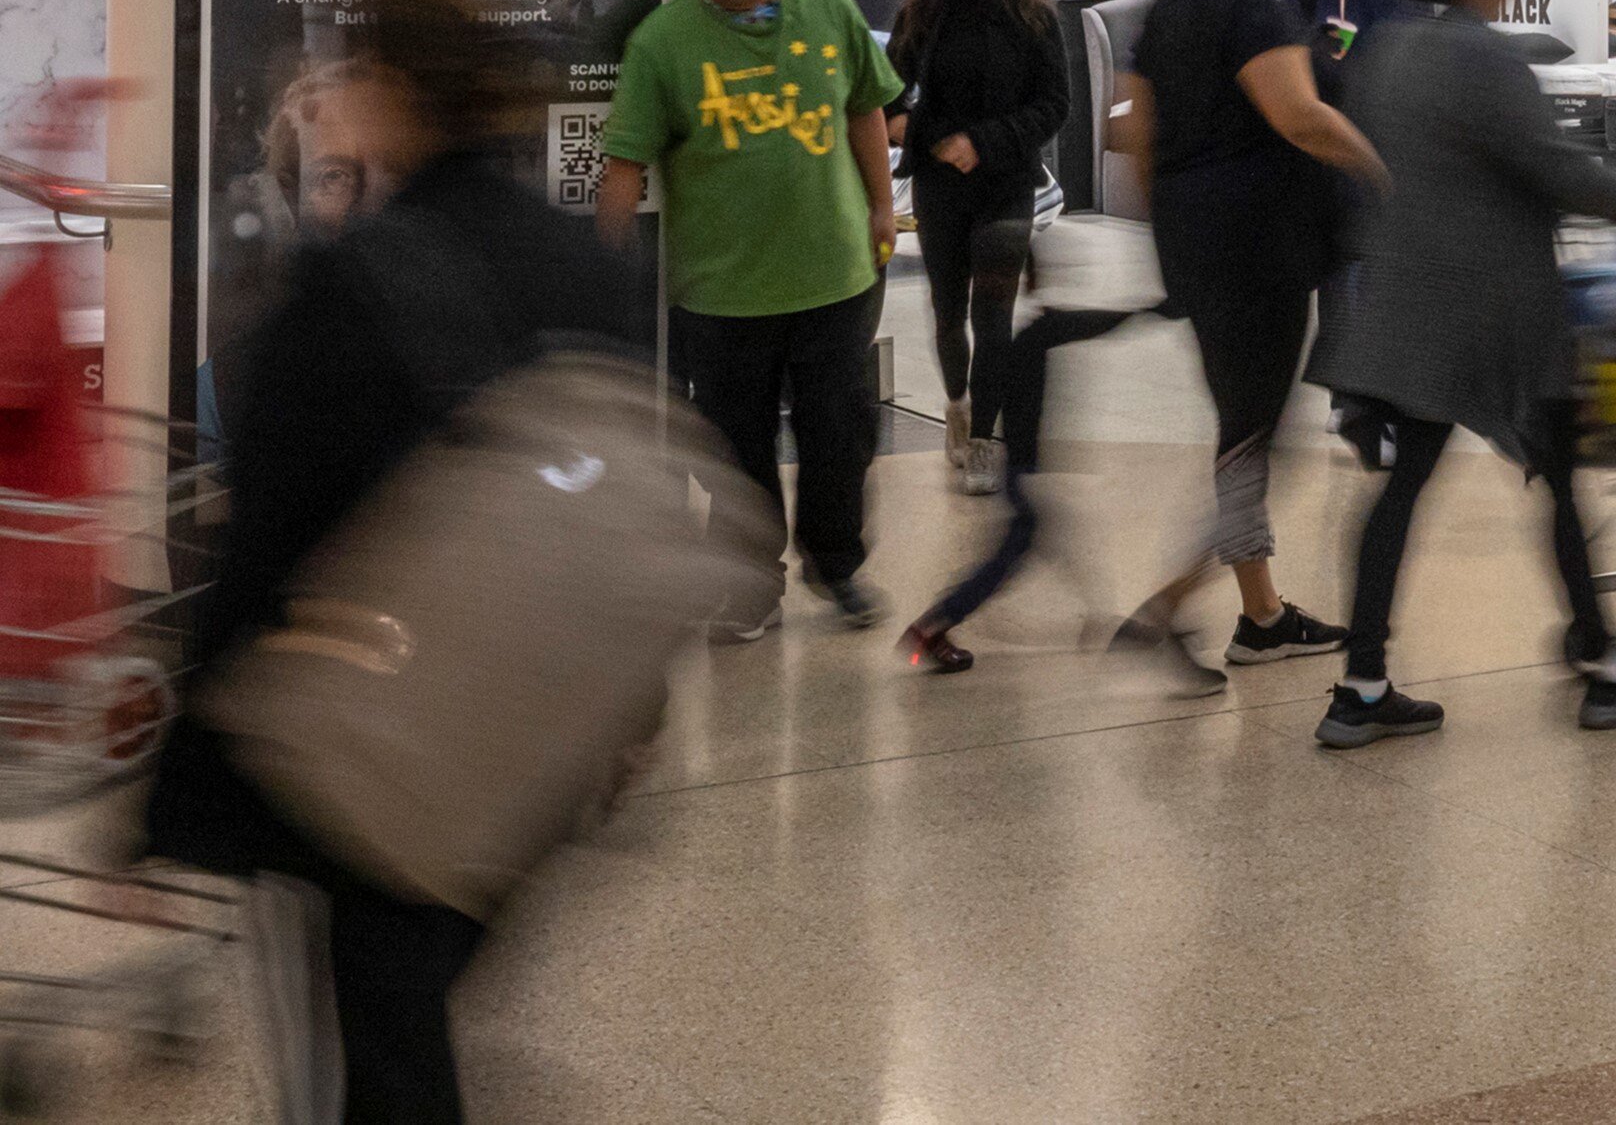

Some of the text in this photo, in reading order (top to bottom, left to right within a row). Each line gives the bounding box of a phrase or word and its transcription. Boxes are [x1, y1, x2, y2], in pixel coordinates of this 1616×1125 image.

[335, 10, 365, 25] But
[478, 8, 552, 25] support.
[570, 64, 607, 75] SCAN
[569, 80, 618, 91] TO DON
